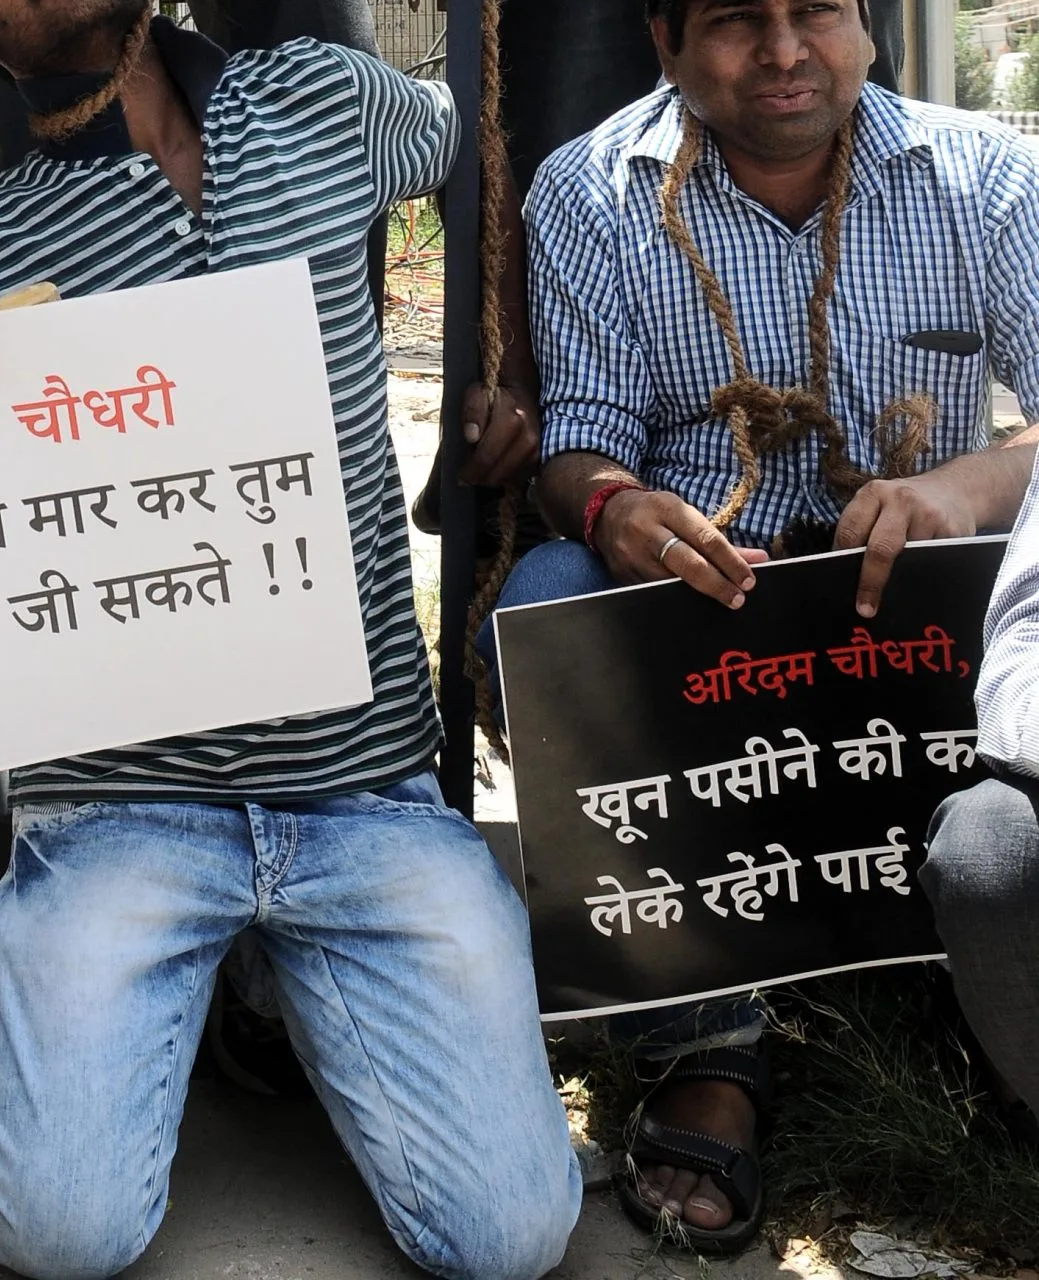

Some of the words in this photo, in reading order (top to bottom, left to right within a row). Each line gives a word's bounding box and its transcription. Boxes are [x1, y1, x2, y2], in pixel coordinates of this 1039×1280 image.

[12, 364, 176, 443] चौधरी
[22, 483, 118, 538] मार
[130, 468, 216, 521] कर
[229, 451, 314, 524] तुम
[7, 568, 79, 634] जी
[93, 541, 233, 624] सकते
[682, 650, 817, 705] अरिंदम
[575, 774, 672, 844] खून
[683, 727, 821, 807] पसीने
[832, 718, 908, 781] की
[583, 868, 685, 937] लेके
[696, 843, 802, 922] रहेंगे
[813, 826, 911, 896] पाई
